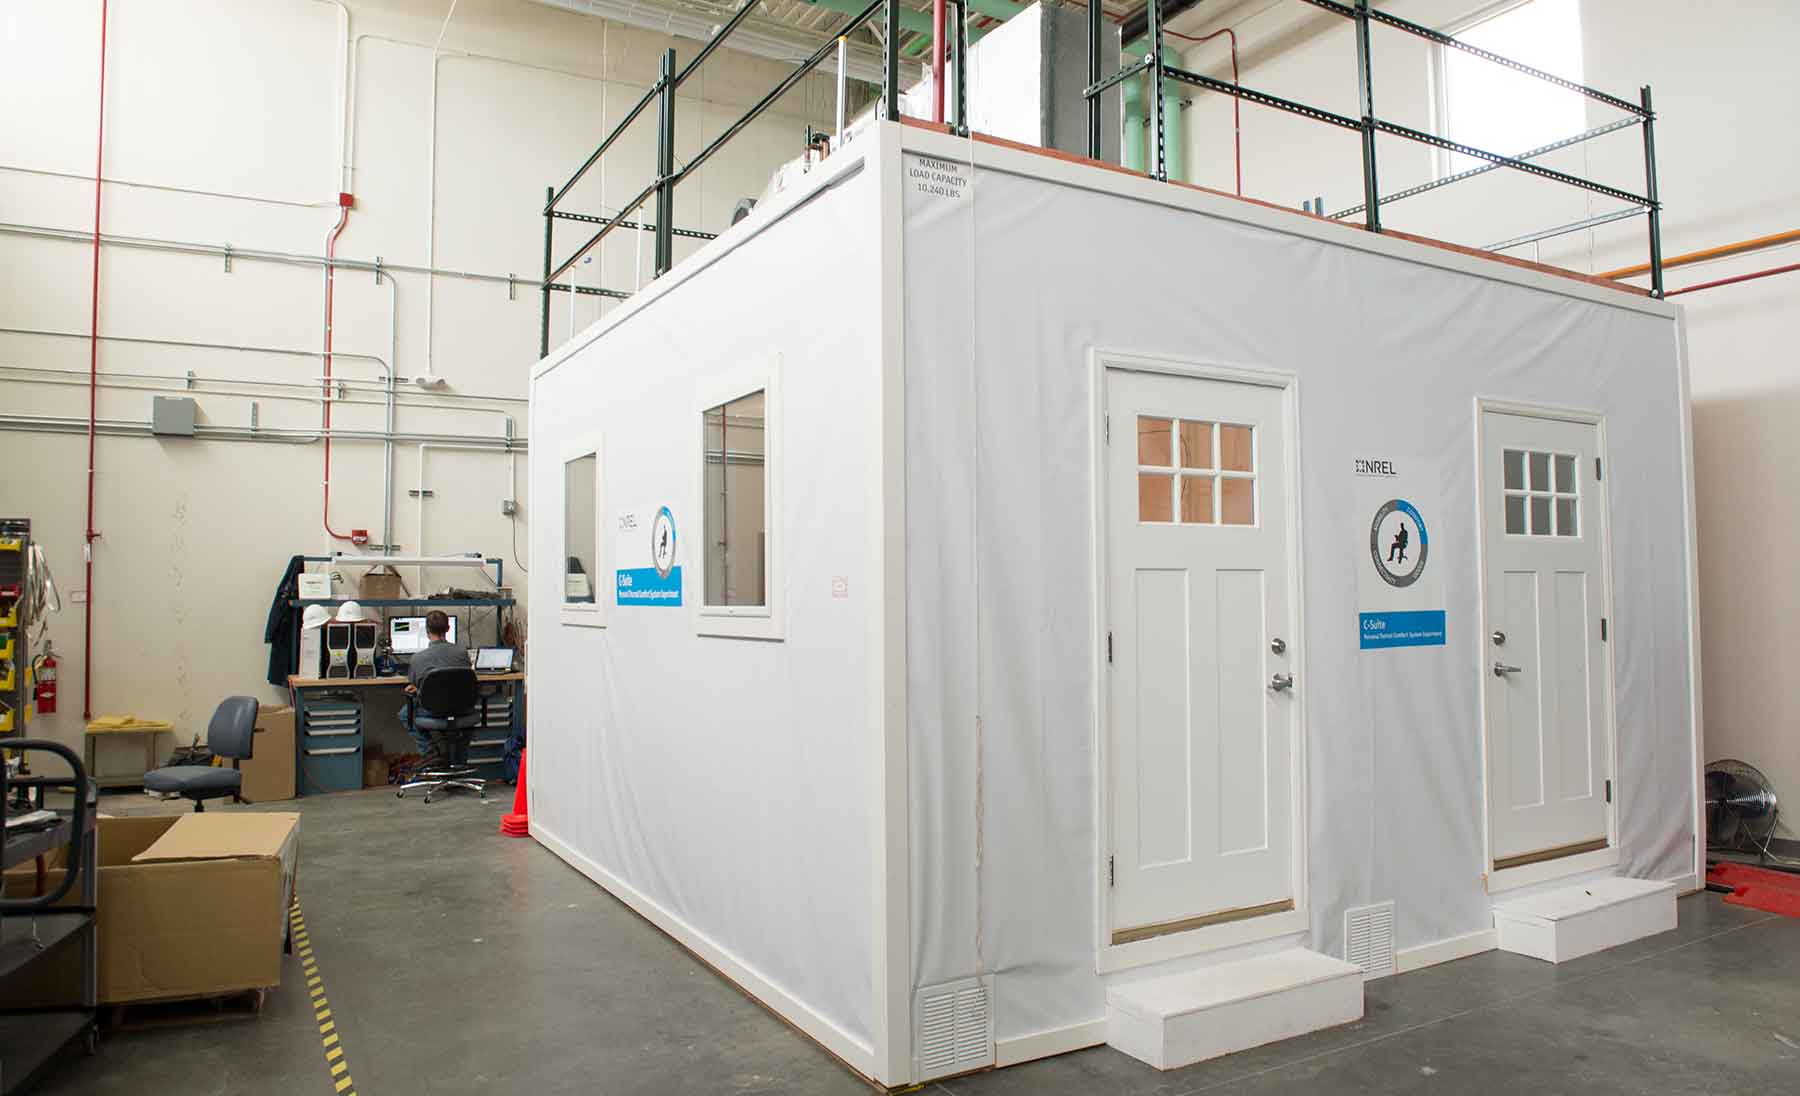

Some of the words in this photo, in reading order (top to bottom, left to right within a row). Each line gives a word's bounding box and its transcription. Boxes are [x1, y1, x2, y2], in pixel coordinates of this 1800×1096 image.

[919, 159, 958, 174] MAXIMUM
[909, 168, 930, 180] LOAD
[931, 171, 968, 188] CAPACITY
[945, 188, 961, 198] LBS
[1365, 459, 1397, 474] NREL
[1362, 618, 1387, 631] C-Suite
